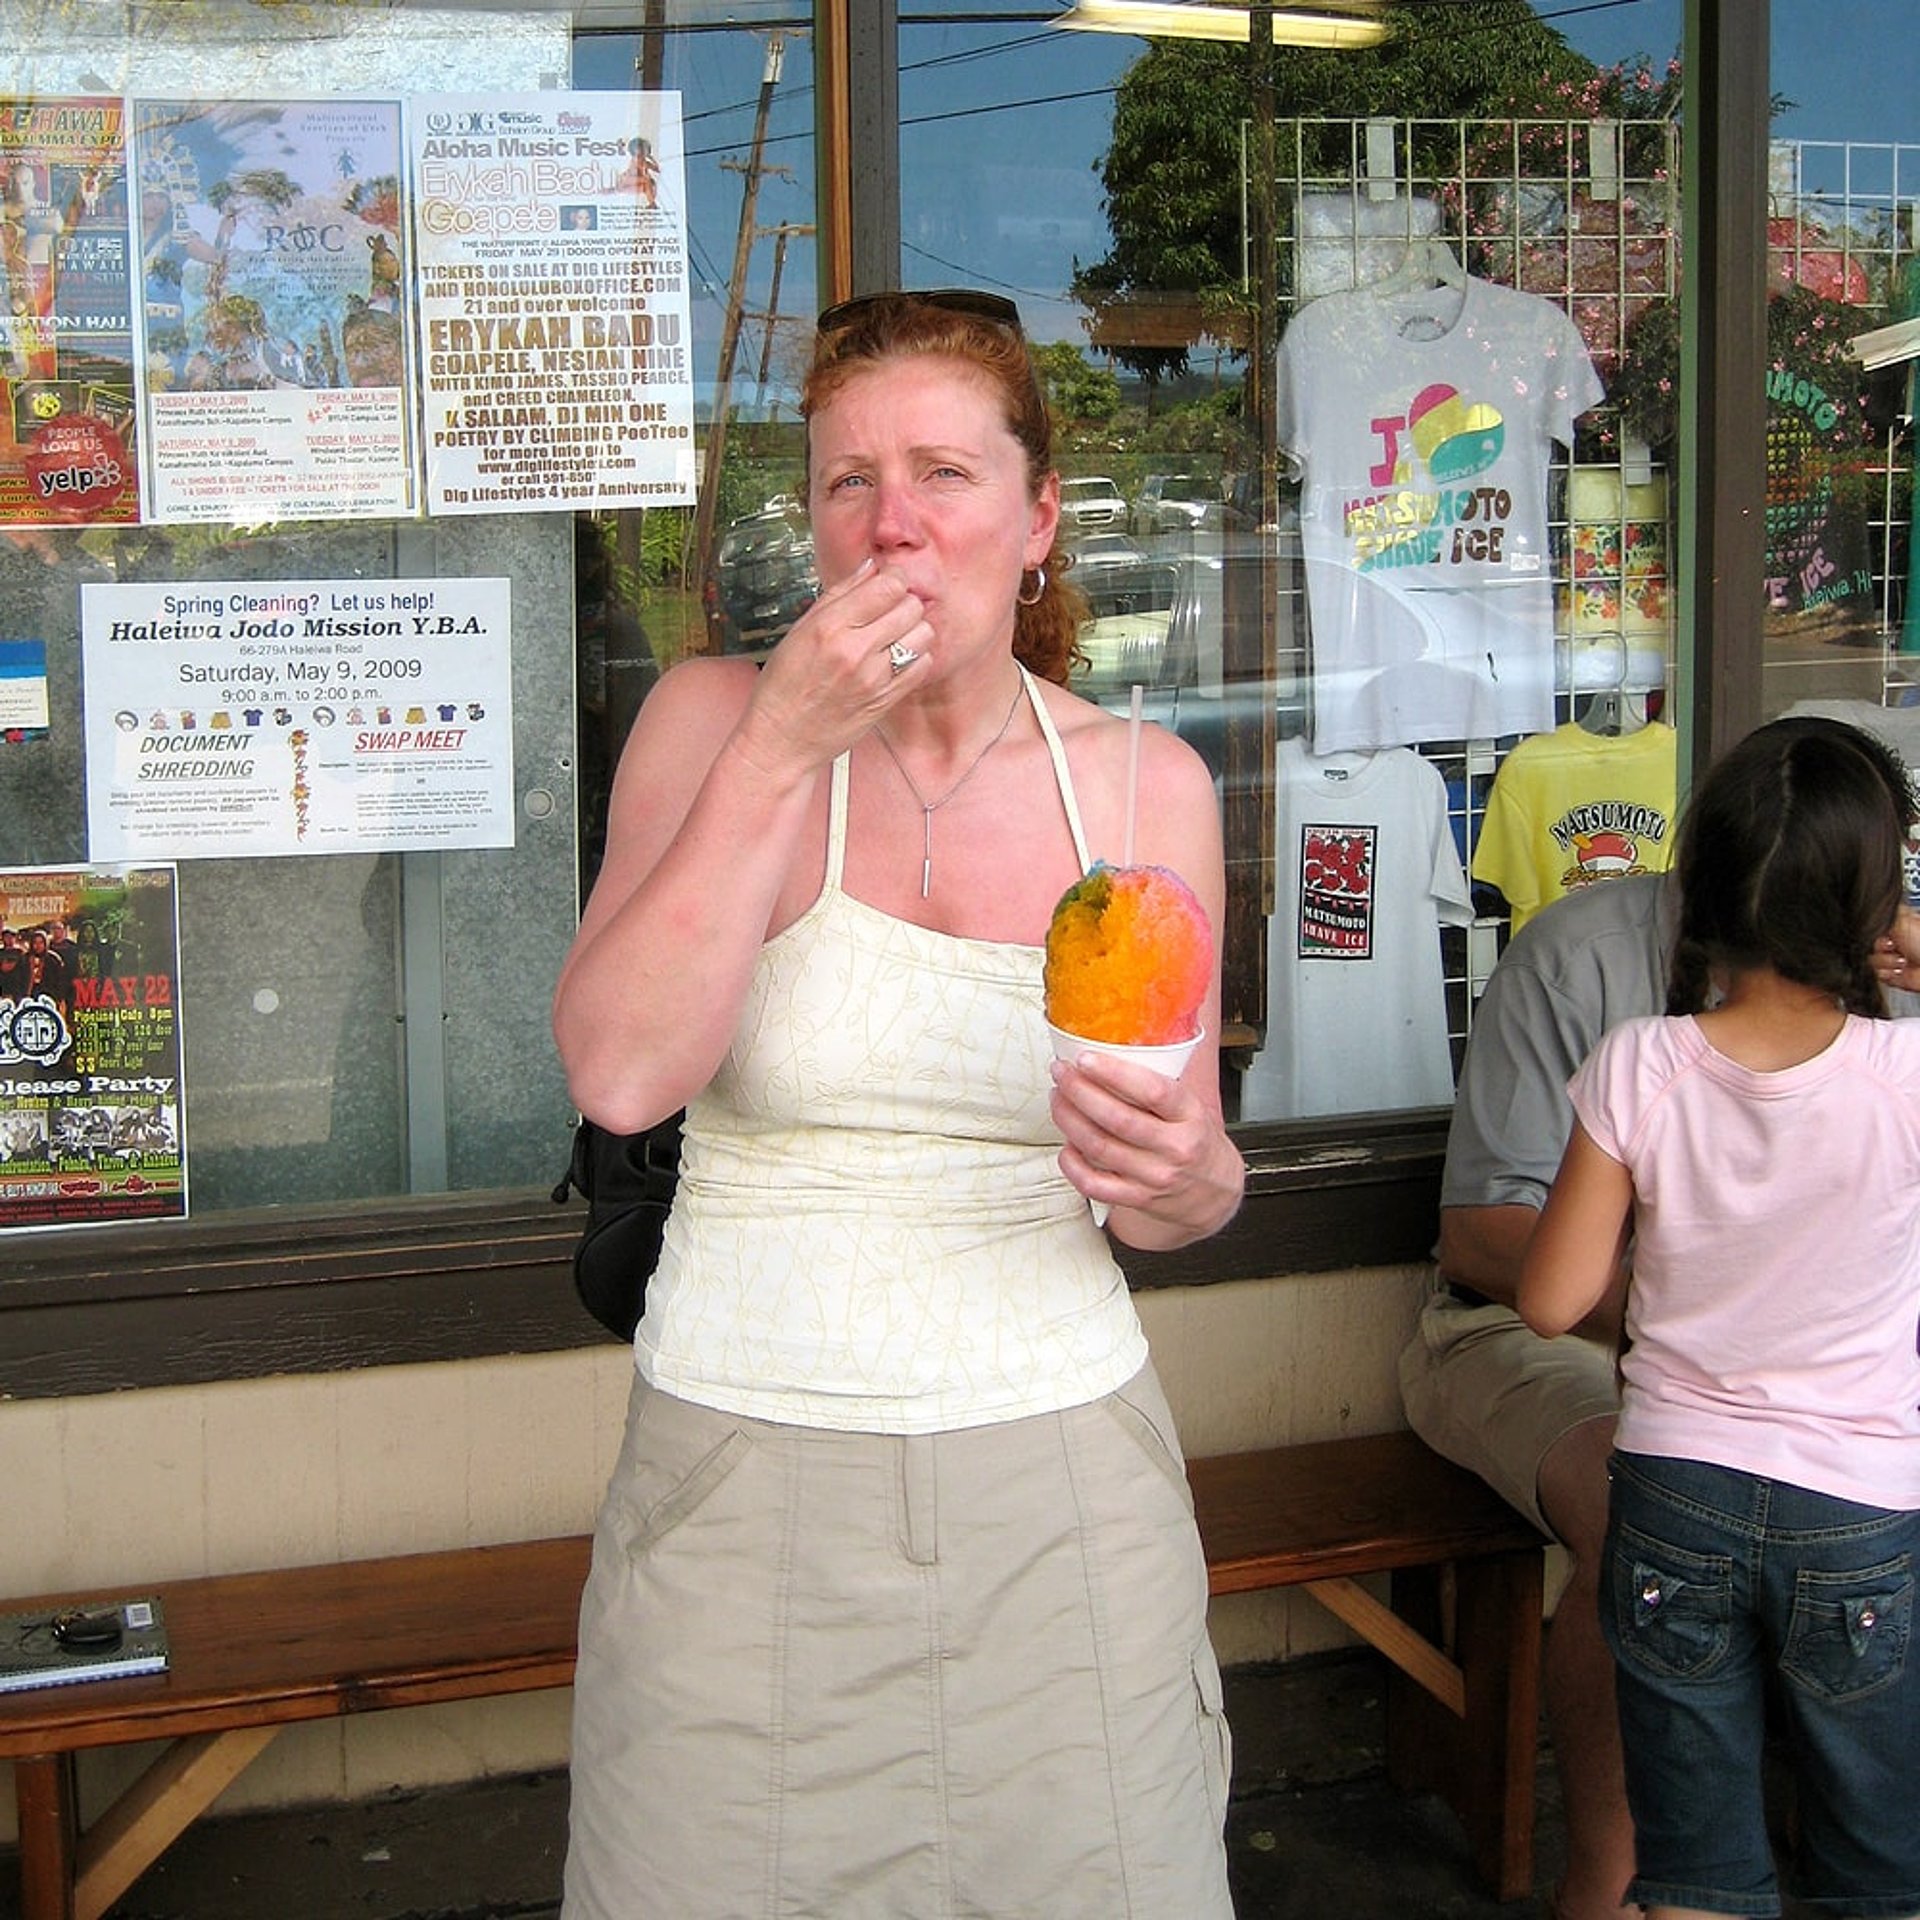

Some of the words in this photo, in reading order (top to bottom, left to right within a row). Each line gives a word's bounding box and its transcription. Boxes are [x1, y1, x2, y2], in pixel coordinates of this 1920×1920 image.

[422, 139, 493, 159] Aloha
[498, 138, 569, 158] Music
[575, 137, 627, 157] Fest
[422, 160, 529, 200] Erykah
[533, 159, 617, 197] Badu
[421, 198, 558, 239] Goapele
[462, 241, 479, 249] THE
[480, 239, 541, 248] WATERFRONT
[550, 238, 581, 247] ALOHA
[581, 238, 612, 247] TOWER
[613, 237, 650, 246] MARKET
[651, 237, 680, 245] PLACE
[475, 248, 515, 259] FRIDAY
[519, 247, 544, 258] MAY
[546, 247, 560, 257] 29
[567, 246, 606, 257] DOORS
[607, 245, 639, 256] OPEN
[640, 245, 655, 255] AT
[656, 244, 681, 255] 7PM
[422, 265, 485, 281] TICKETS
[488, 264, 510, 279] ON
[512, 262, 549, 278] SALE
[551, 262, 570, 277] AT
[572, 262, 599, 277] DIG
[601, 260, 683, 276] LIFESTYLES
[424, 282, 459, 299] AND
[463, 277, 682, 298] HONOLULUBOXOFFICE.COM
[464, 300, 483, 315] 21
[486, 298, 520, 314] and
[523, 299, 563, 312] over
[567, 295, 647, 312] welcome
[429, 317, 572, 351] ERYKAH
[582, 313, 681, 348] BADU
[430, 352, 537, 376] GOAPELE,
[542, 349, 626, 373] NESIAN
[631, 347, 685, 370] NINE
[430, 376, 471, 392] WITH
[474, 374, 514, 391] KIMO
[571, 371, 628, 388] TASSHO
[462, 393, 493, 408] and
[495, 390, 543, 407] CREED
[446, 410, 460, 429] K
[556, 405, 580, 425] DJ
[585, 403, 624, 423] MIN
[628, 402, 668, 422] ONE
[48, 426, 96, 439] PEOPLE
[434, 430, 500, 448] POETRY
[502, 428, 526, 445] BY
[528, 426, 614, 444] CLIMBING
[617, 424, 689, 442] PoeTree
[42, 441, 81, 454] LOVE
[83, 437, 104, 450] US
[483, 448, 506, 461] for
[509, 447, 549, 460] more
[551, 444, 582, 459] info
[607, 444, 622, 457] to
[1370, 415, 1406, 488] I
[40, 467, 94, 494] yelp
[501, 475, 515, 487] or
[517, 473, 541, 486] call
[443, 488, 470, 505] Dig
[472, 484, 547, 502] Lifestyles
[549, 485, 560, 499] 4
[561, 483, 596, 500] year
[598, 480, 688, 498] Anniversary
[1451, 527, 1505, 564] ICE
[1799, 547, 1835, 596] ICE
[164, 595, 224, 618] Spring
[229, 594, 320, 616] Cleaning?
[331, 593, 360, 612] Let
[362, 596, 386, 612] us
[391, 592, 435, 614] help!
[110, 620, 222, 642] Haleiwa
[228, 619, 295, 640] Jodo
[302, 617, 403, 639] Mission
[412, 616, 489, 637] Y.B.A.
[289, 643, 333, 655] Haleiwa
[335, 643, 363, 654] Road
[178, 662, 281, 686] Saturday,
[286, 660, 330, 684] May
[337, 660, 358, 681] 9,
[364, 659, 423, 680] 2009
[221, 689, 257, 703] 9:00
[260, 691, 292, 702] a.m.
[296, 689, 310, 701] to
[313, 687, 349, 701] 2:00
[352, 689, 383, 703] p.m.
[140, 733, 253, 754] DOCUMENT
[354, 730, 413, 751] SWAP
[414, 729, 468, 749] MEET
[138, 759, 256, 779] SHREDDING
[1551, 802, 1667, 850] MATSUMOTO
[8, 895, 71, 916] PRESENT:
[1304, 905, 1367, 929] MATSUMOTO
[1304, 922, 1337, 942] SHAVE
[1344, 932, 1366, 946] ICE
[73, 976, 137, 1009] MAY
[144, 975, 170, 1005] 22
[73, 1009, 114, 1023] Pipeline
[120, 1008, 143, 1020] Cafe
[76, 1056, 95, 1074] $3
[87, 1076, 175, 1094] Party
